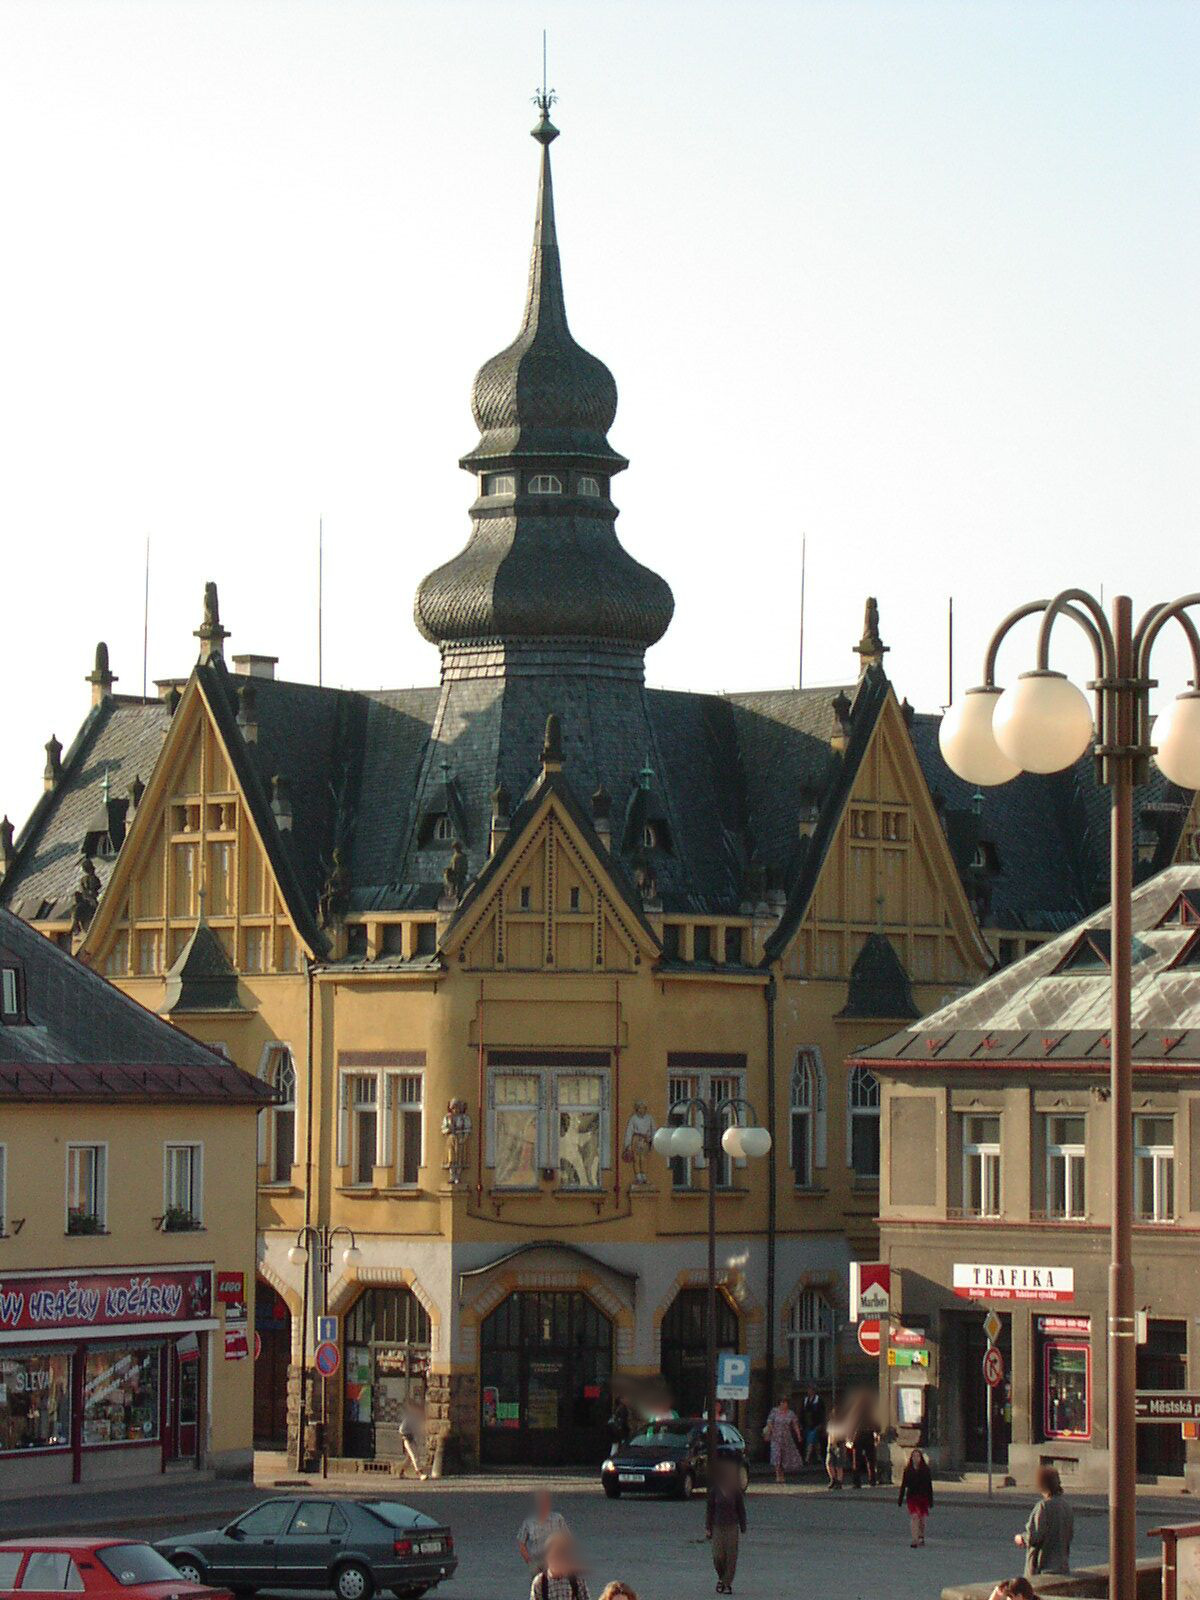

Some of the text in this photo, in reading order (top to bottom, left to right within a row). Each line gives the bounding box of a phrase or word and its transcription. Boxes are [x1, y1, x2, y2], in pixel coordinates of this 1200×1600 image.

[220, 1282, 241, 1292] LEGO
[973, 1267, 1055, 1287] TRAFIKA
[0, 1277, 183, 1325] VY HRAČKY KOČÁRKY
[723, 1359, 746, 1383] P
[1150, 1399, 1193, 1414] Městská
